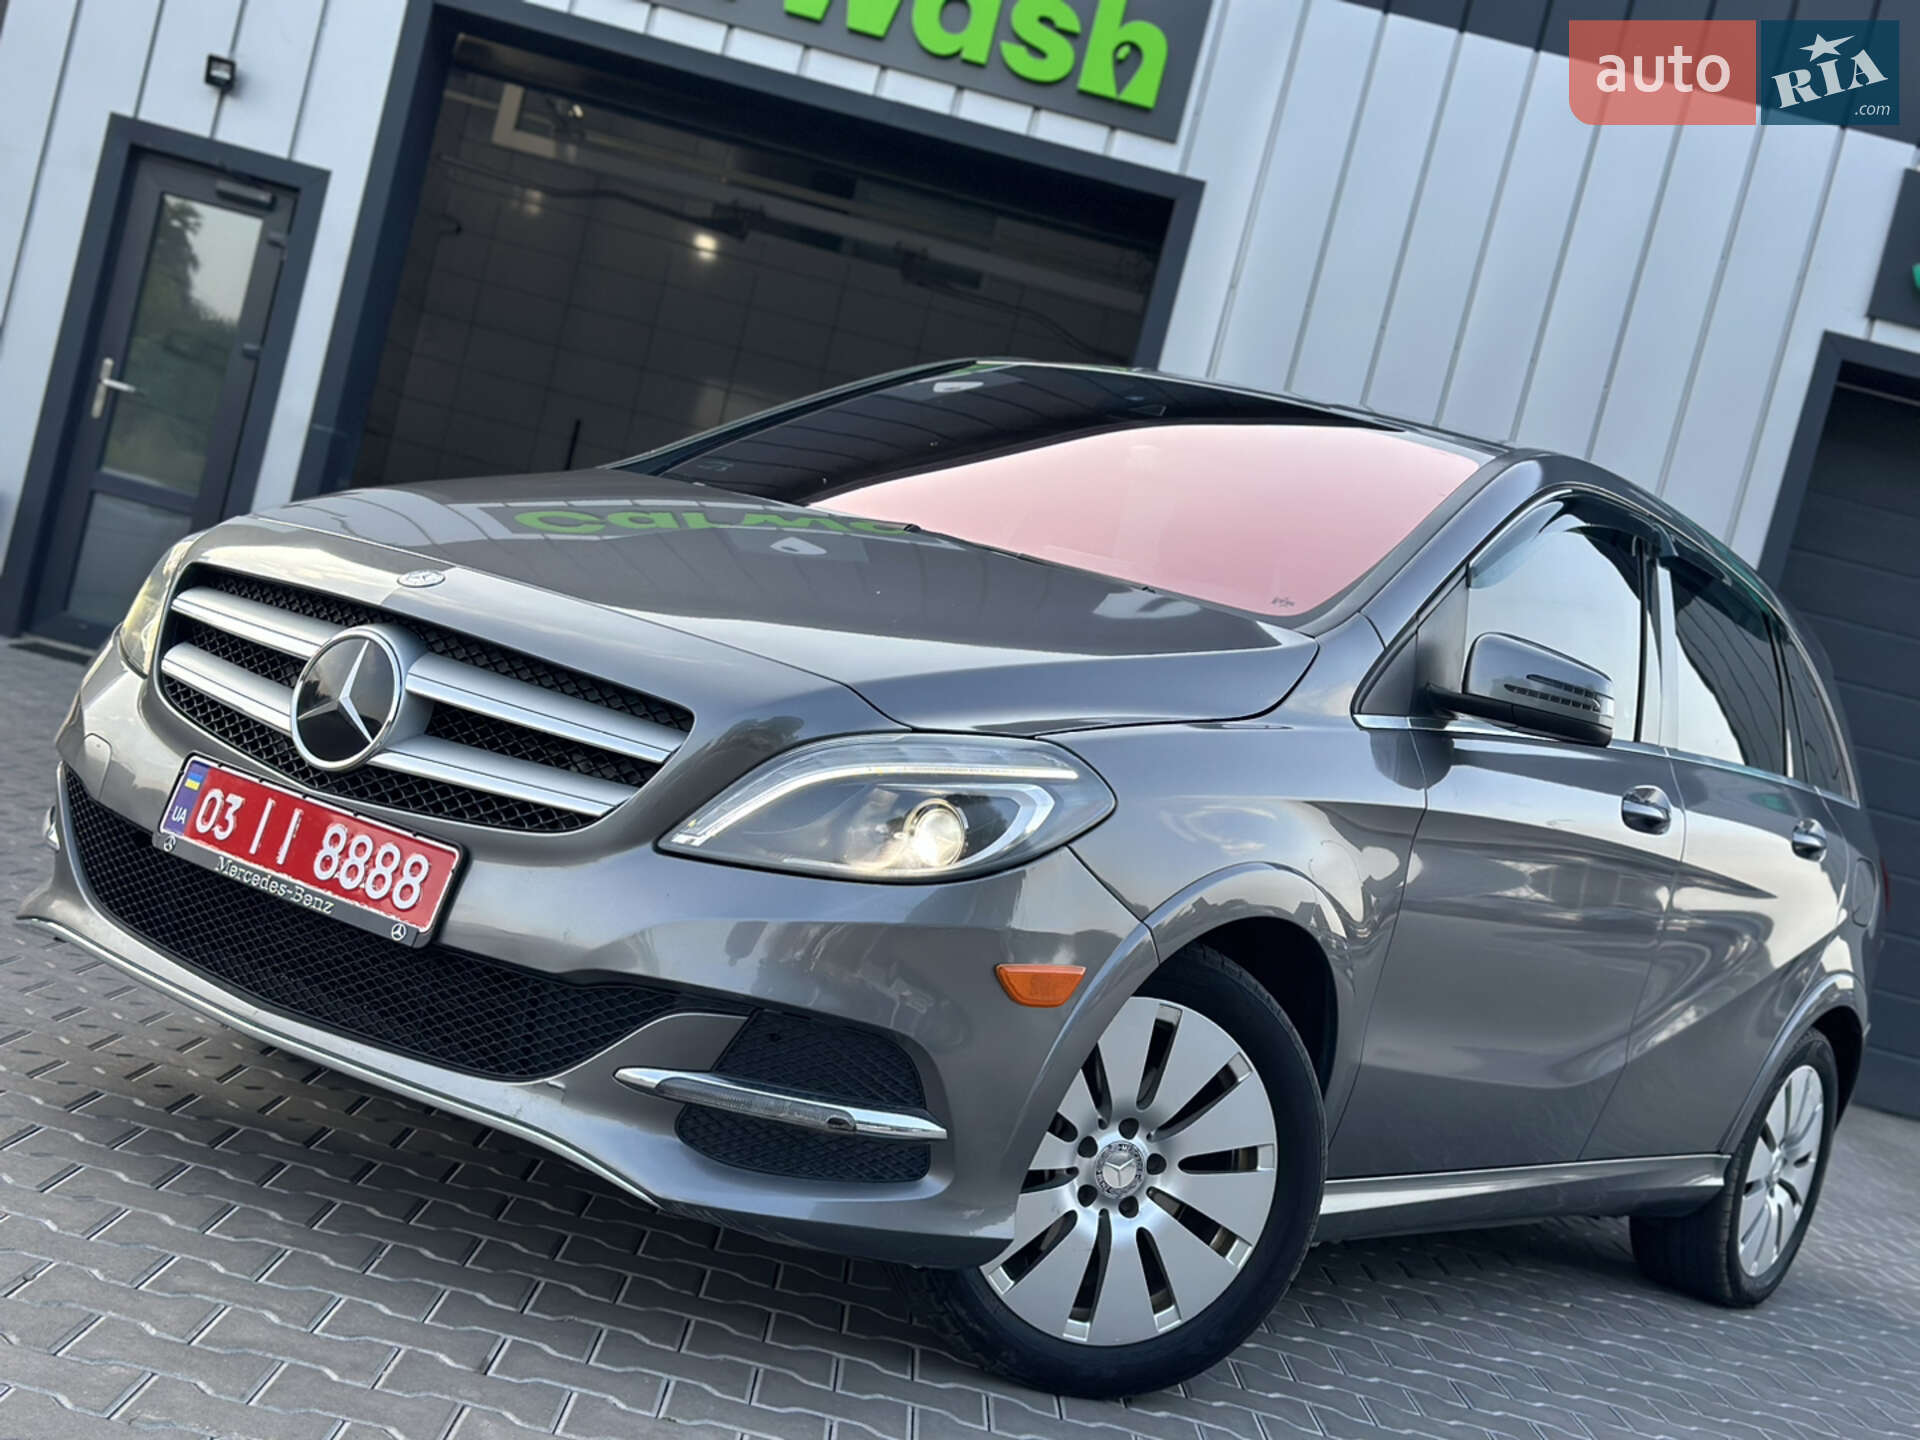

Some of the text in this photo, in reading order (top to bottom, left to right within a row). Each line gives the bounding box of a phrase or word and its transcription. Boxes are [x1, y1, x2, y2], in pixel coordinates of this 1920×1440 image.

[172, 806, 188, 824] UA
[195, 789, 244, 840] 03
[313, 824, 430, 909] 8888
[215, 856, 335, 914] Mercedes-Benz
